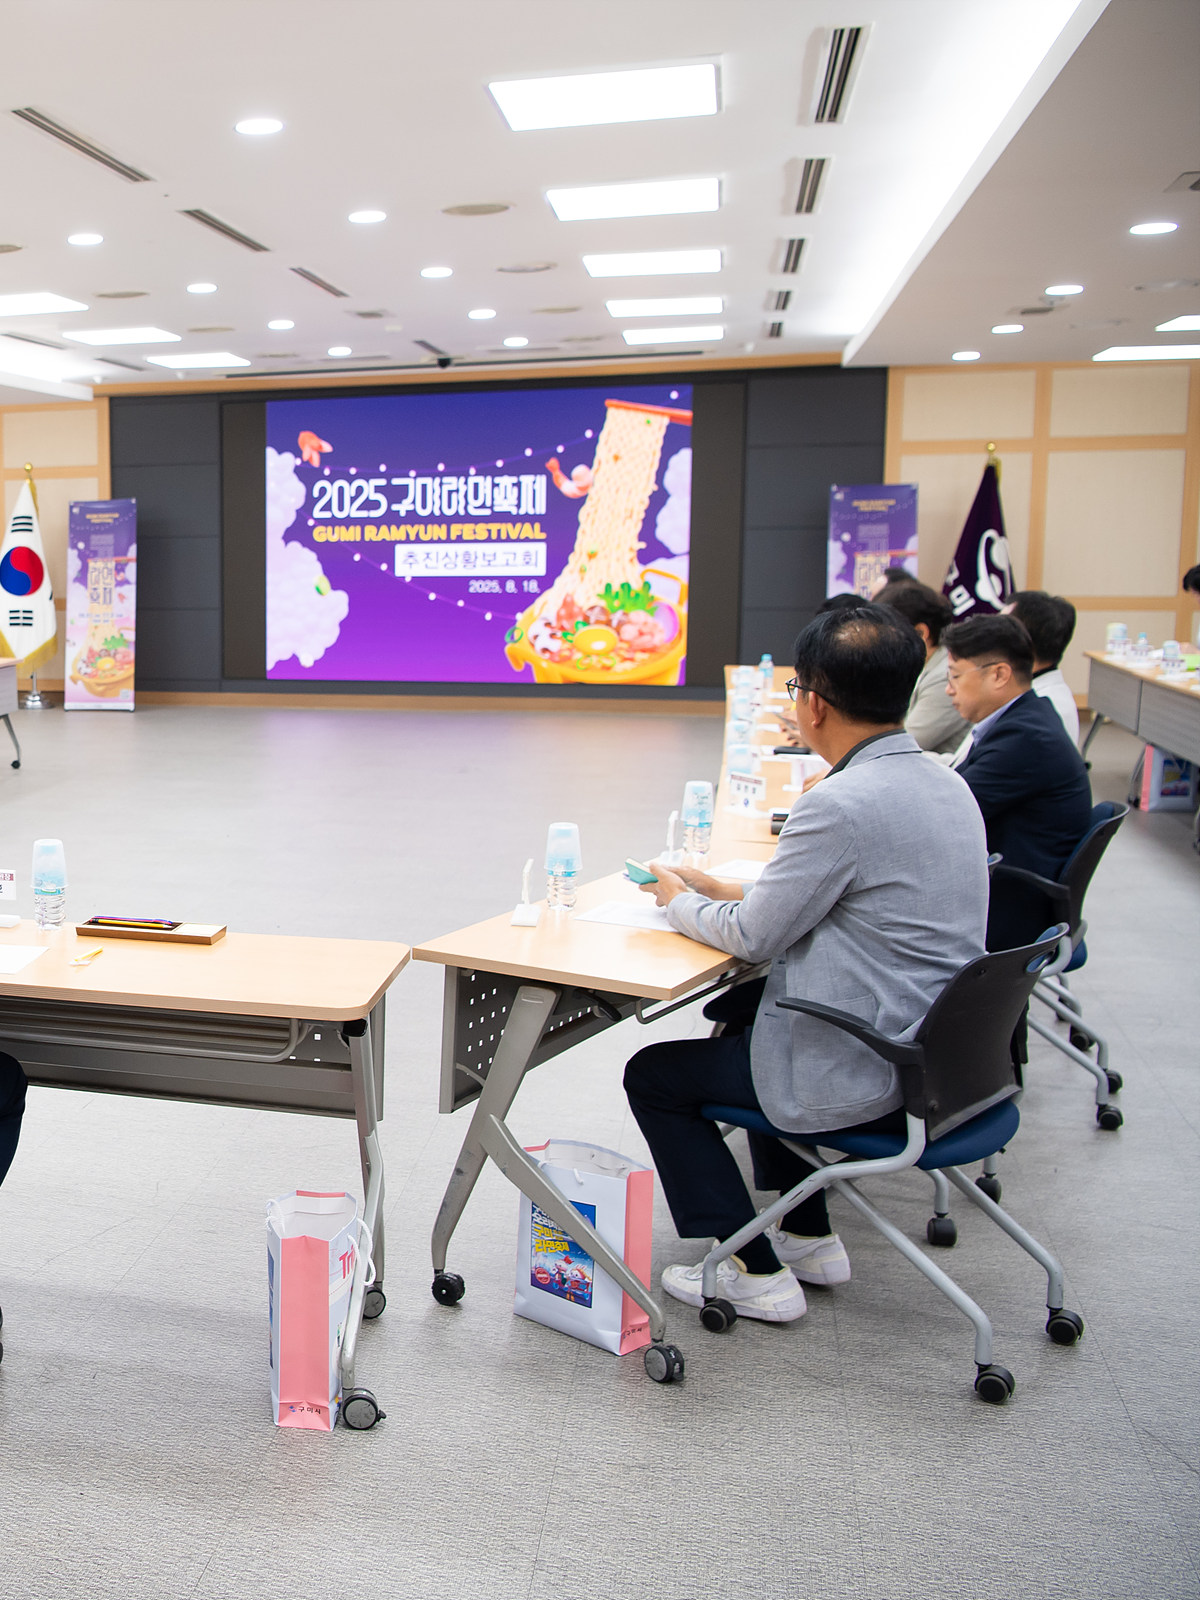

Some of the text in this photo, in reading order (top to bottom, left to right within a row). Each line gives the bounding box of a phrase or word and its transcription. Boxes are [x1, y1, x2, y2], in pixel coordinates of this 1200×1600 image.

[312, 474, 547, 519] 2025 구미라면축제
[312, 522, 547, 543] GUMI RAMYUN FESTIVAL
[402, 550, 539, 570] 추진상황보고회
